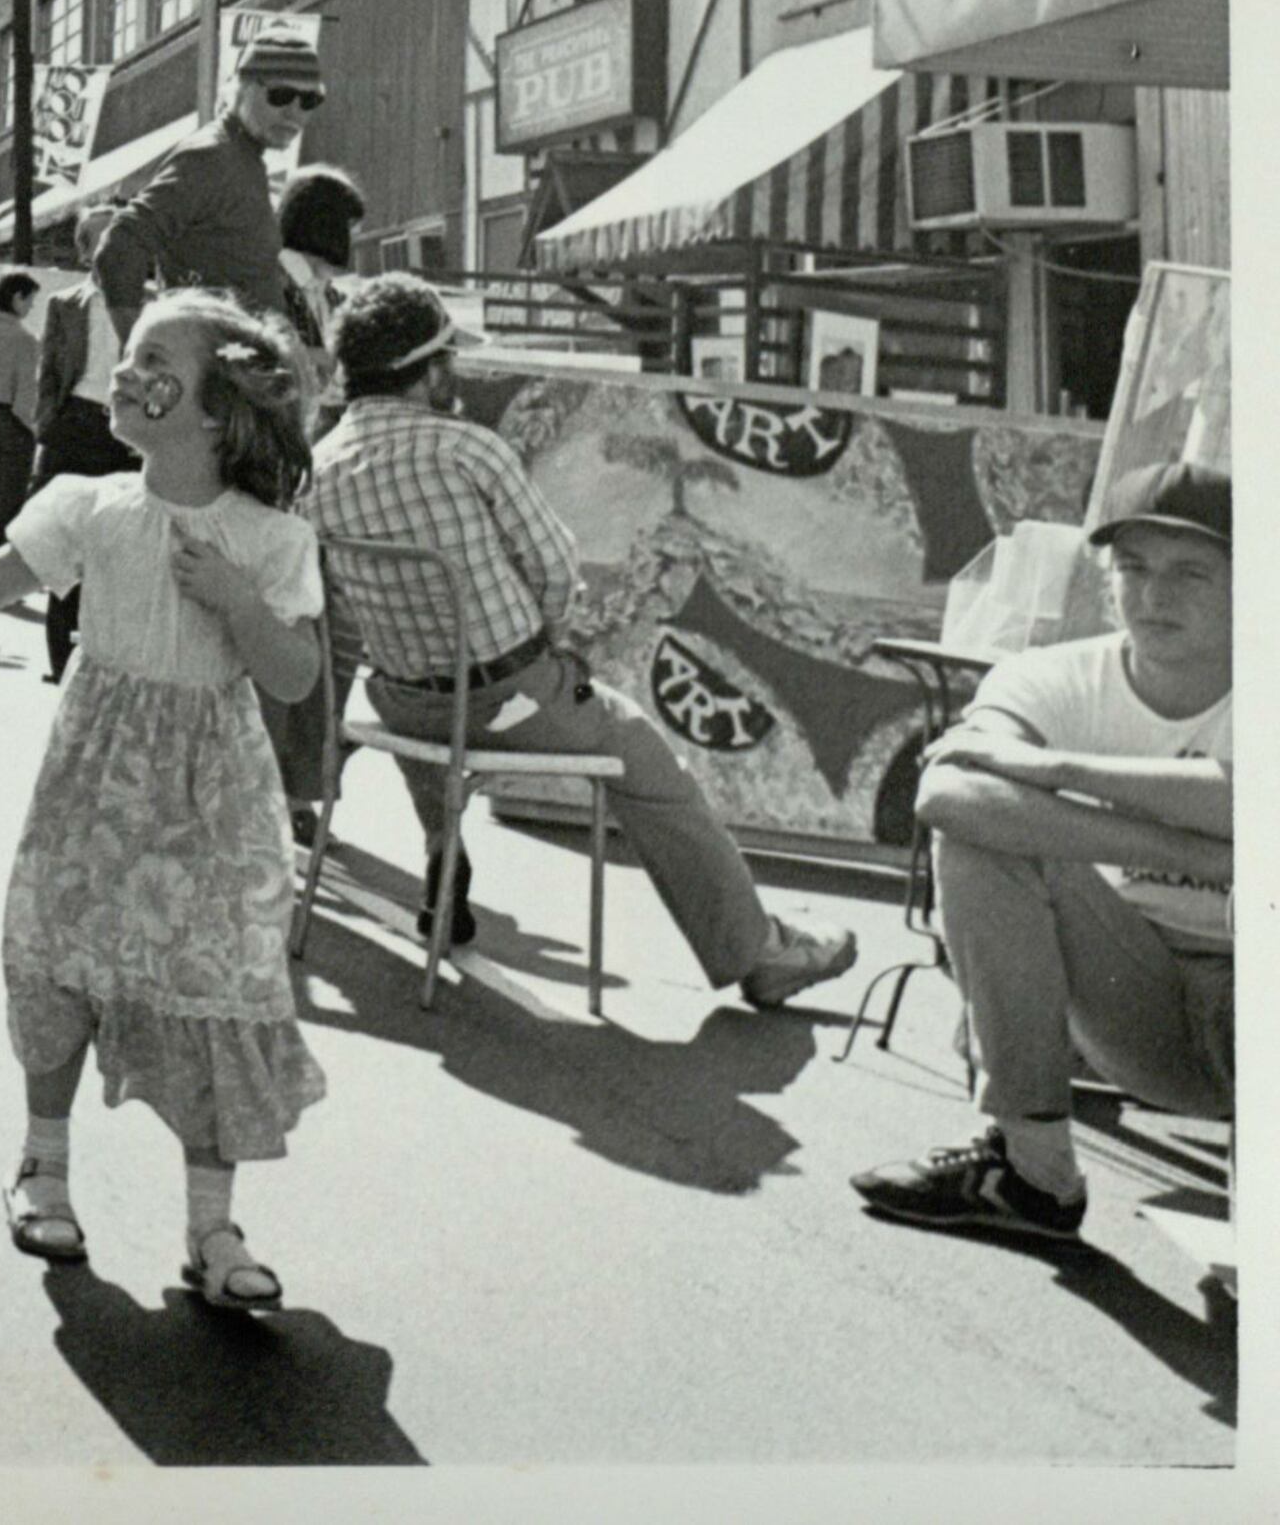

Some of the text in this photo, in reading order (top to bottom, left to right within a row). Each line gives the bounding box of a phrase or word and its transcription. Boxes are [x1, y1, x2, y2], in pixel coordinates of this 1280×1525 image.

[514, 51, 611, 118] PUB
[685, 396, 839, 468] ART
[659, 640, 753, 746] ART
